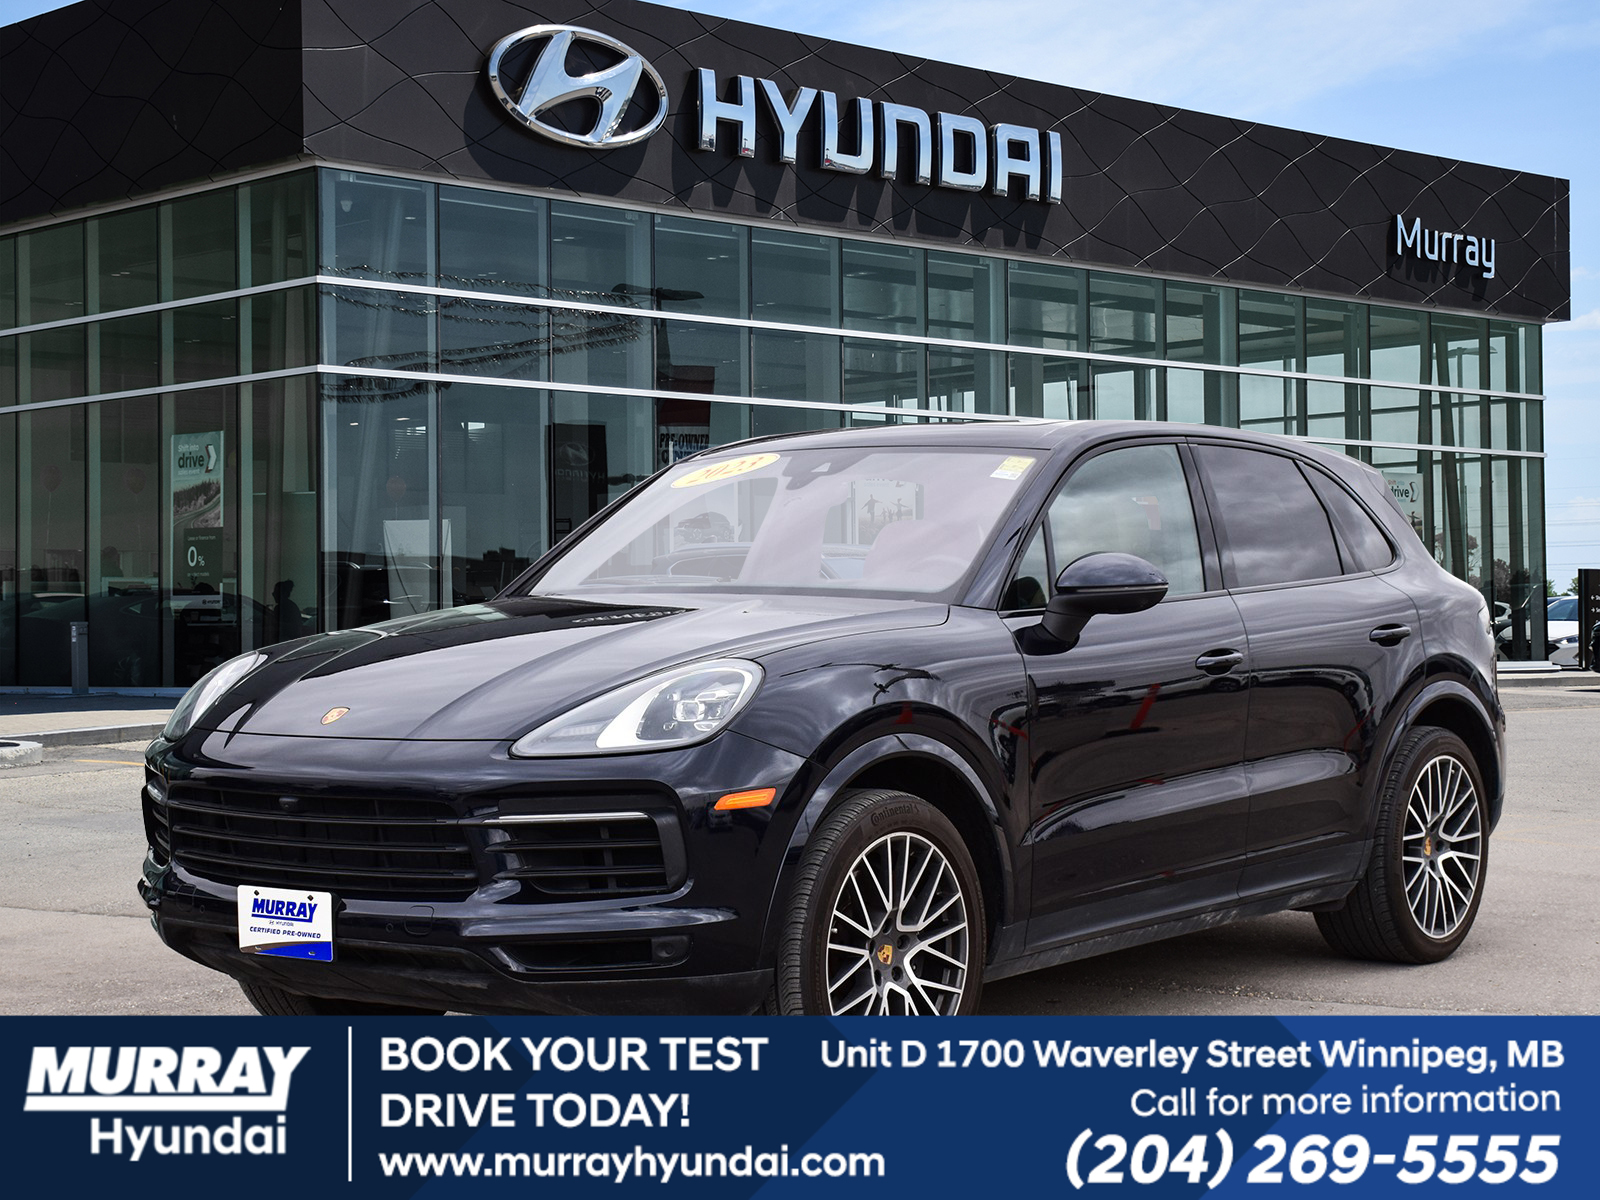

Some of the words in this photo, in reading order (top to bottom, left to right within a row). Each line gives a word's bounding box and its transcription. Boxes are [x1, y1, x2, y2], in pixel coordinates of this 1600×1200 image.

[696, 66, 1063, 205] HYUNDAI
[1395, 213, 1496, 279] Murray
[177, 444, 189, 453] Shift
[189, 443, 200, 451] into
[177, 452, 205, 469] drive
[870, 803, 913, 826] Continental
[251, 897, 318, 923] MURRAY
[249, 926, 281, 935] CERTIFIED
[282, 929, 322, 939] PRE-OWNED
